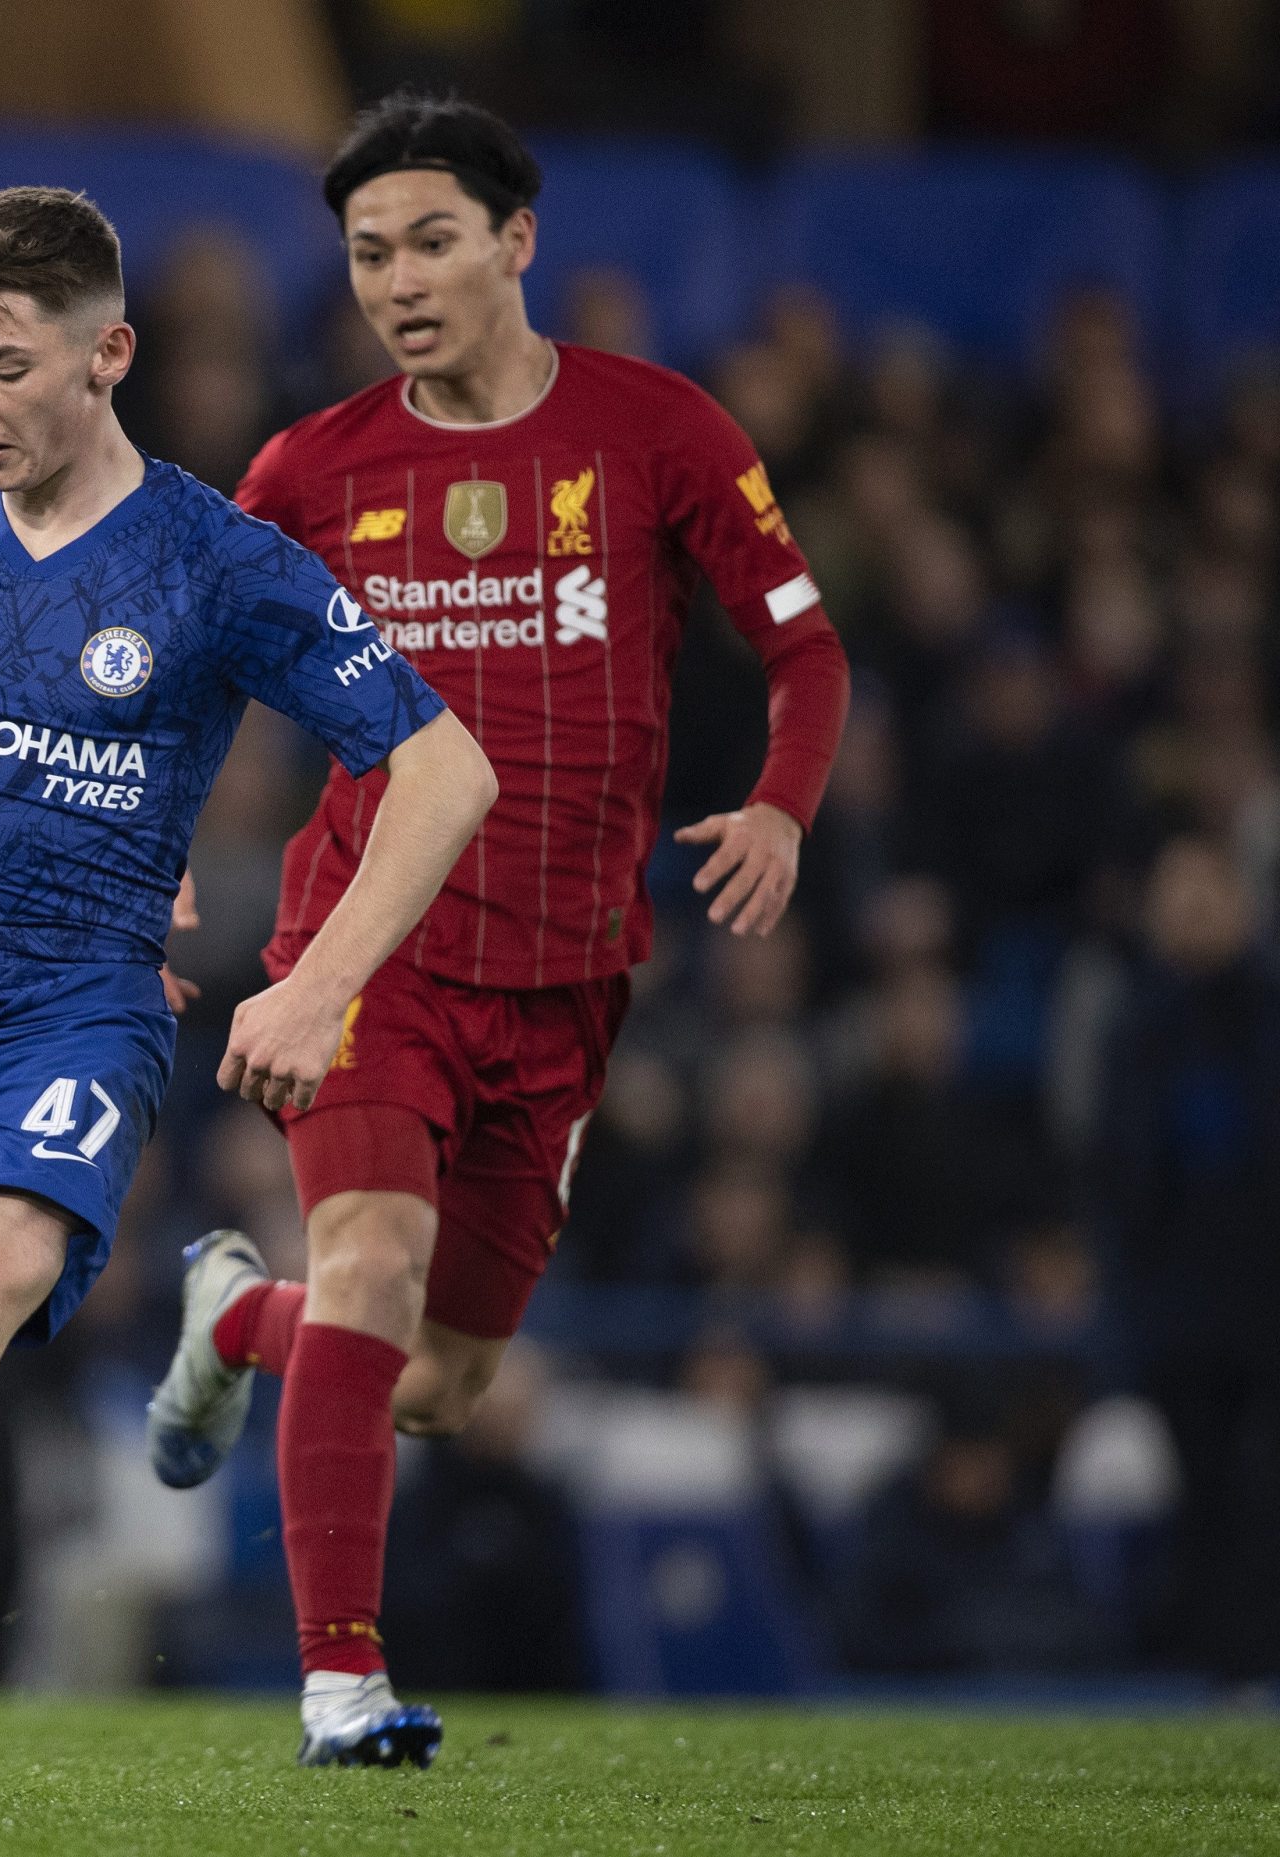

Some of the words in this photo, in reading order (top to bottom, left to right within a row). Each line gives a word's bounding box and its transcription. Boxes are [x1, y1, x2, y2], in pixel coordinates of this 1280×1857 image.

[547, 530, 593, 557] LFC
[363, 566, 543, 612] Standard
[98, 629, 143, 648] CHELSEA
[376, 610, 546, 651] hartered
[89, 676, 118, 694] FOOTBALL
[120, 682, 136, 693] CLUB
[41, 774, 144, 811] TYRES
[20, 1077, 121, 1160] 47
